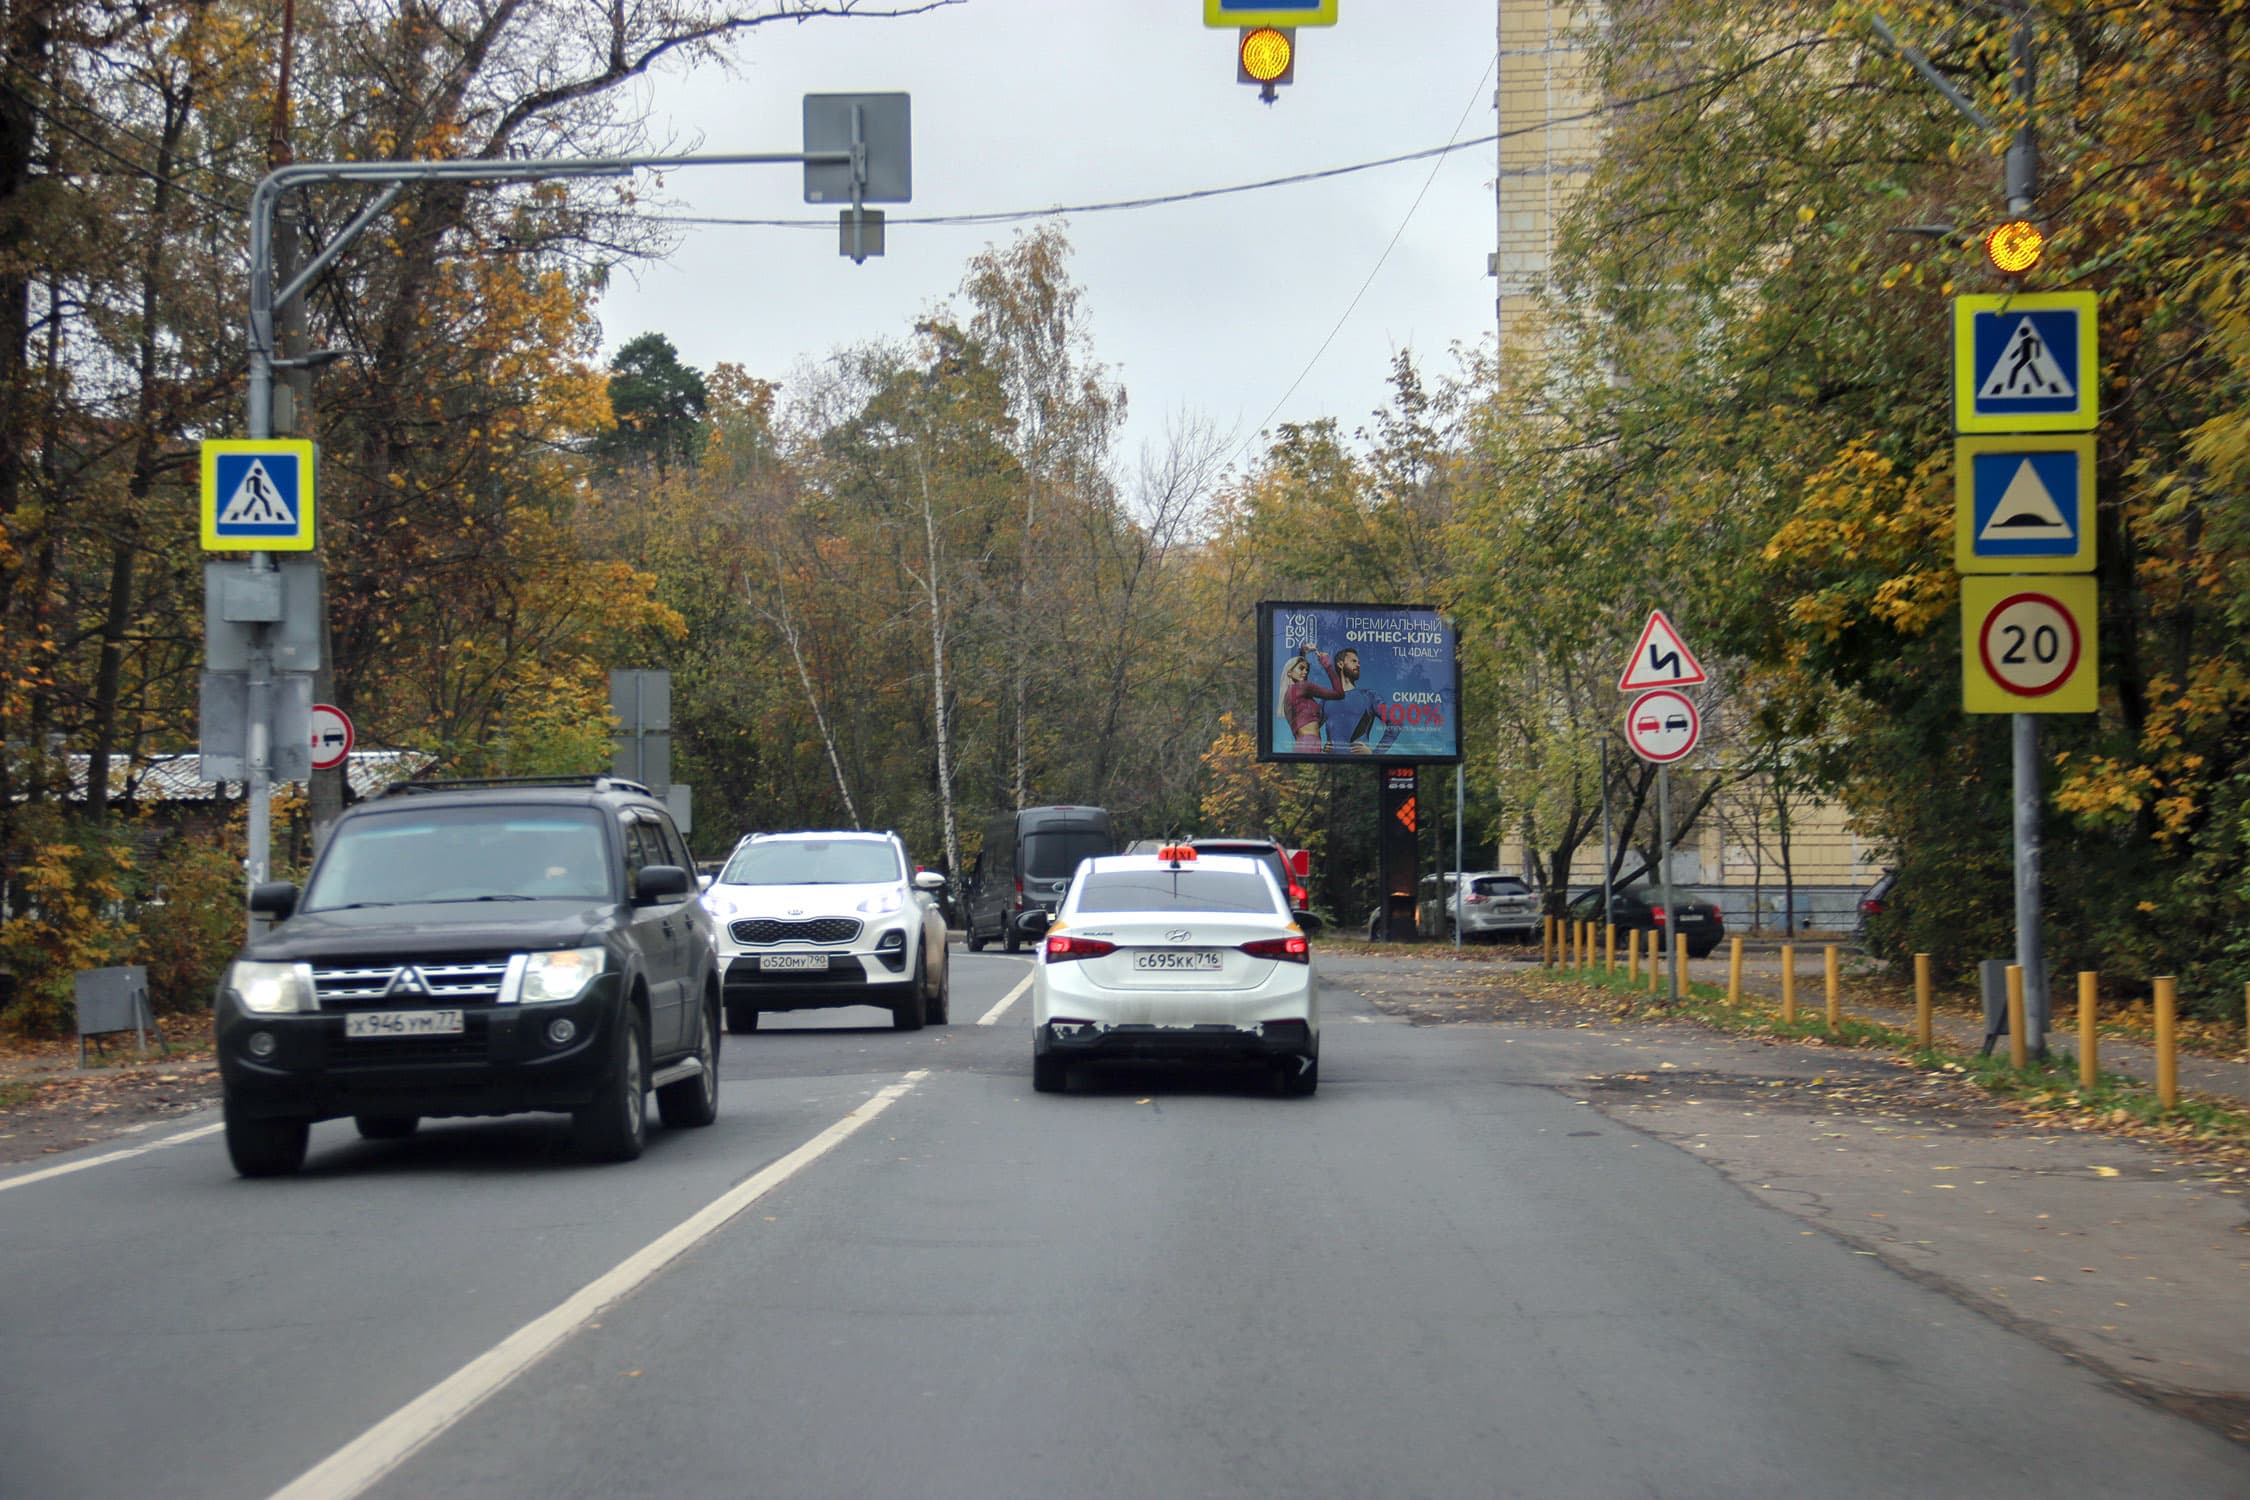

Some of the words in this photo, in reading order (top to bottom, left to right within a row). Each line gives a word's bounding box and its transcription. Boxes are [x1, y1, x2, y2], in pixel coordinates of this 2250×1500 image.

[1345, 617, 1442, 632] ПРЕМИАЛЬНЫЙ
[1345, 630, 1442, 644] ФИТНЕС-КЛУБ
[2001, 624, 2059, 664] 20
[1393, 646, 1408, 658] ТЦ
[1392, 691, 1442, 704] СКИДКА
[1376, 703, 1444, 726] 100%
[1164, 850, 1192, 861] TAXI
